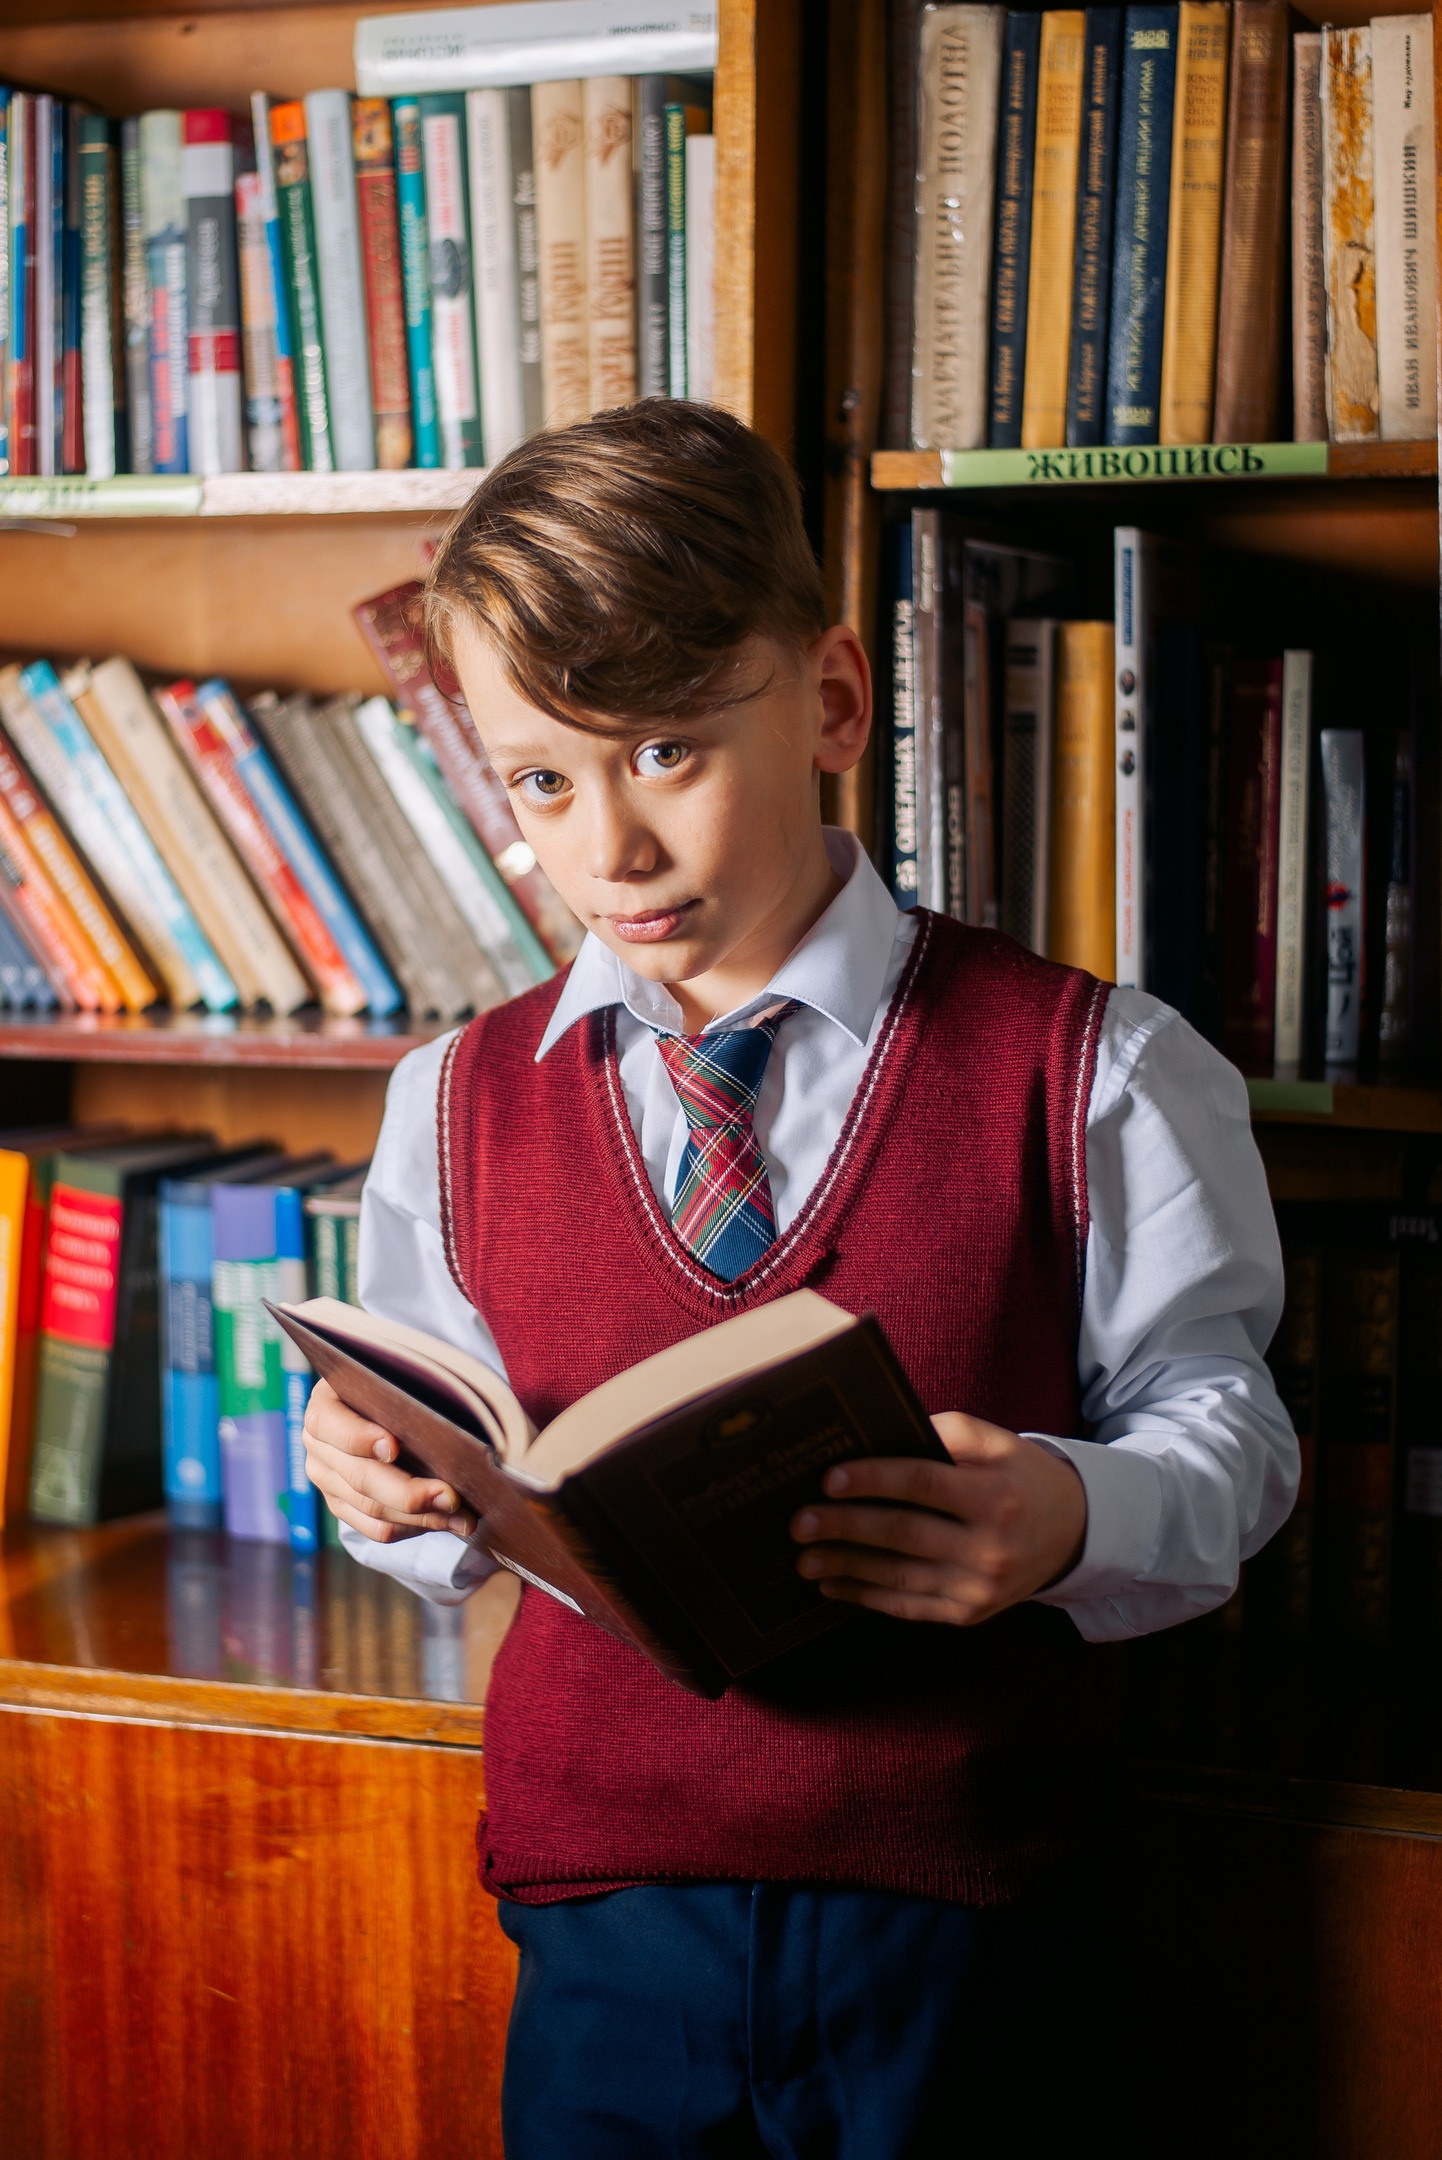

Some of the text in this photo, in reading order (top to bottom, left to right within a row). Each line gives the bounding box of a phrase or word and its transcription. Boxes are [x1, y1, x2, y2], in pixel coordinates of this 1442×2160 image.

[1139, 59, 1155, 101] РИМА
[930, 23, 969, 448] ЗАМЕЧАТЕЛЬНЫЕ ПОЛОТНА
[1401, 145, 1419, 410] ИВАН ИВАНОВИЧ ШИШКИН
[1027, 444, 1266, 480] ЖИВОПИСЬ
[893, 600, 916, 892] 25 ОПЕРНЫХ ШЕДЕВРОВ
[1327, 925, 1355, 986] Цой
